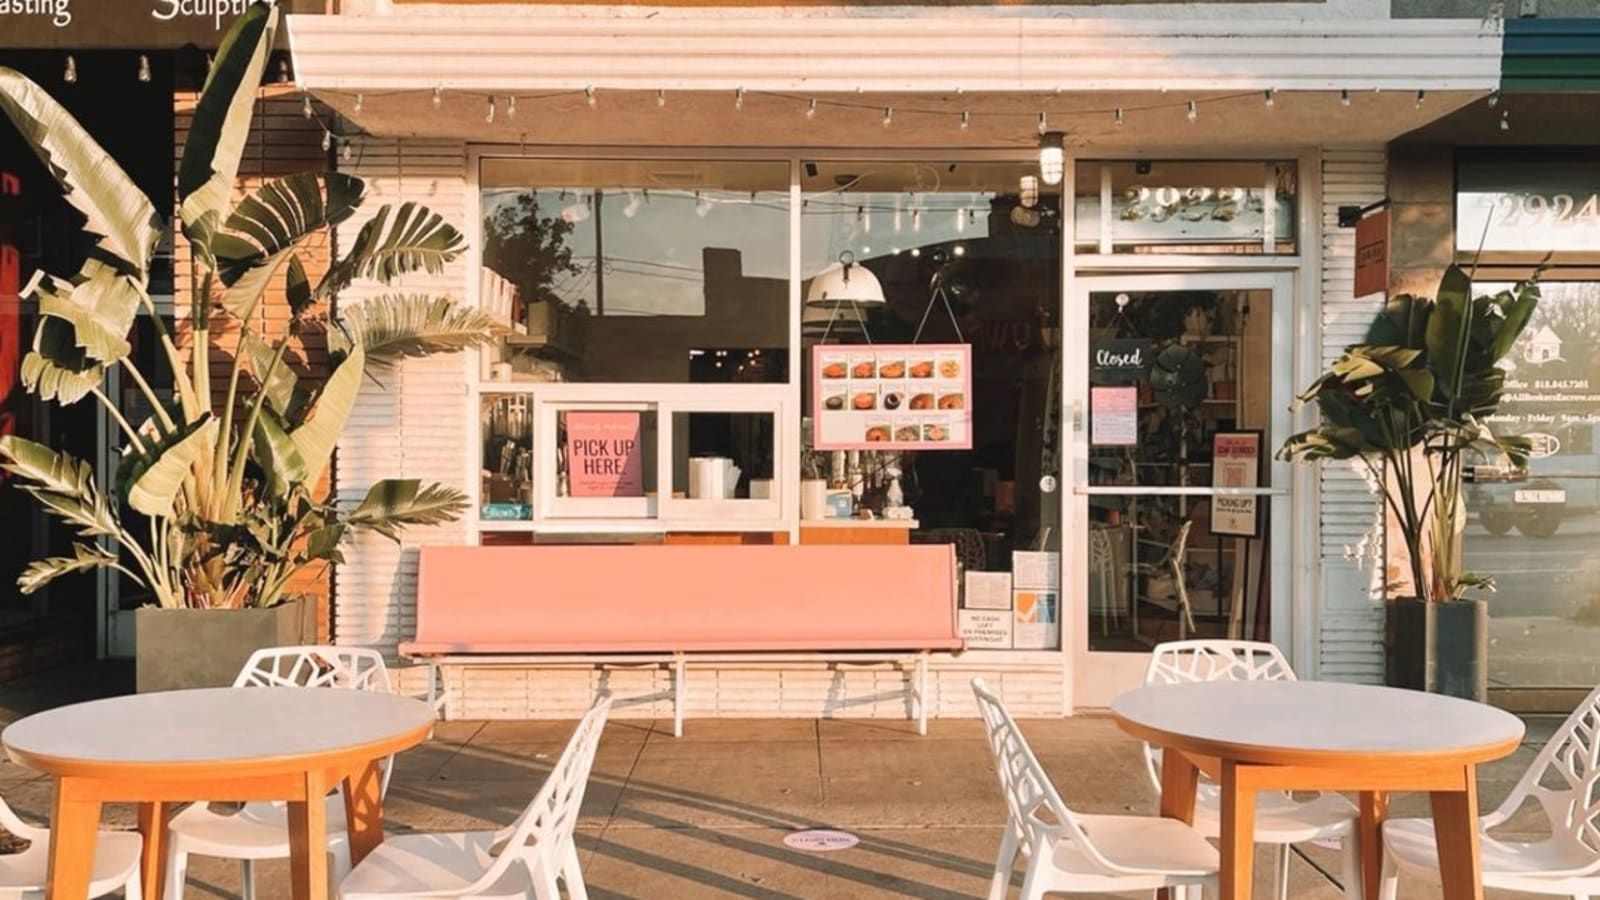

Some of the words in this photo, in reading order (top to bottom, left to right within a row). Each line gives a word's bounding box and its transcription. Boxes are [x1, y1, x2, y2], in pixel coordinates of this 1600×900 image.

[152, 0, 276, 30] Sculpti
[1120, 187, 1244, 223] 2922
[1499, 193, 1600, 227] 2924
[1096, 348, 1142, 367] Closed
[573, 438, 608, 456] PICK
[613, 438, 635, 456] UP
[583, 458, 627, 475] HERE.
